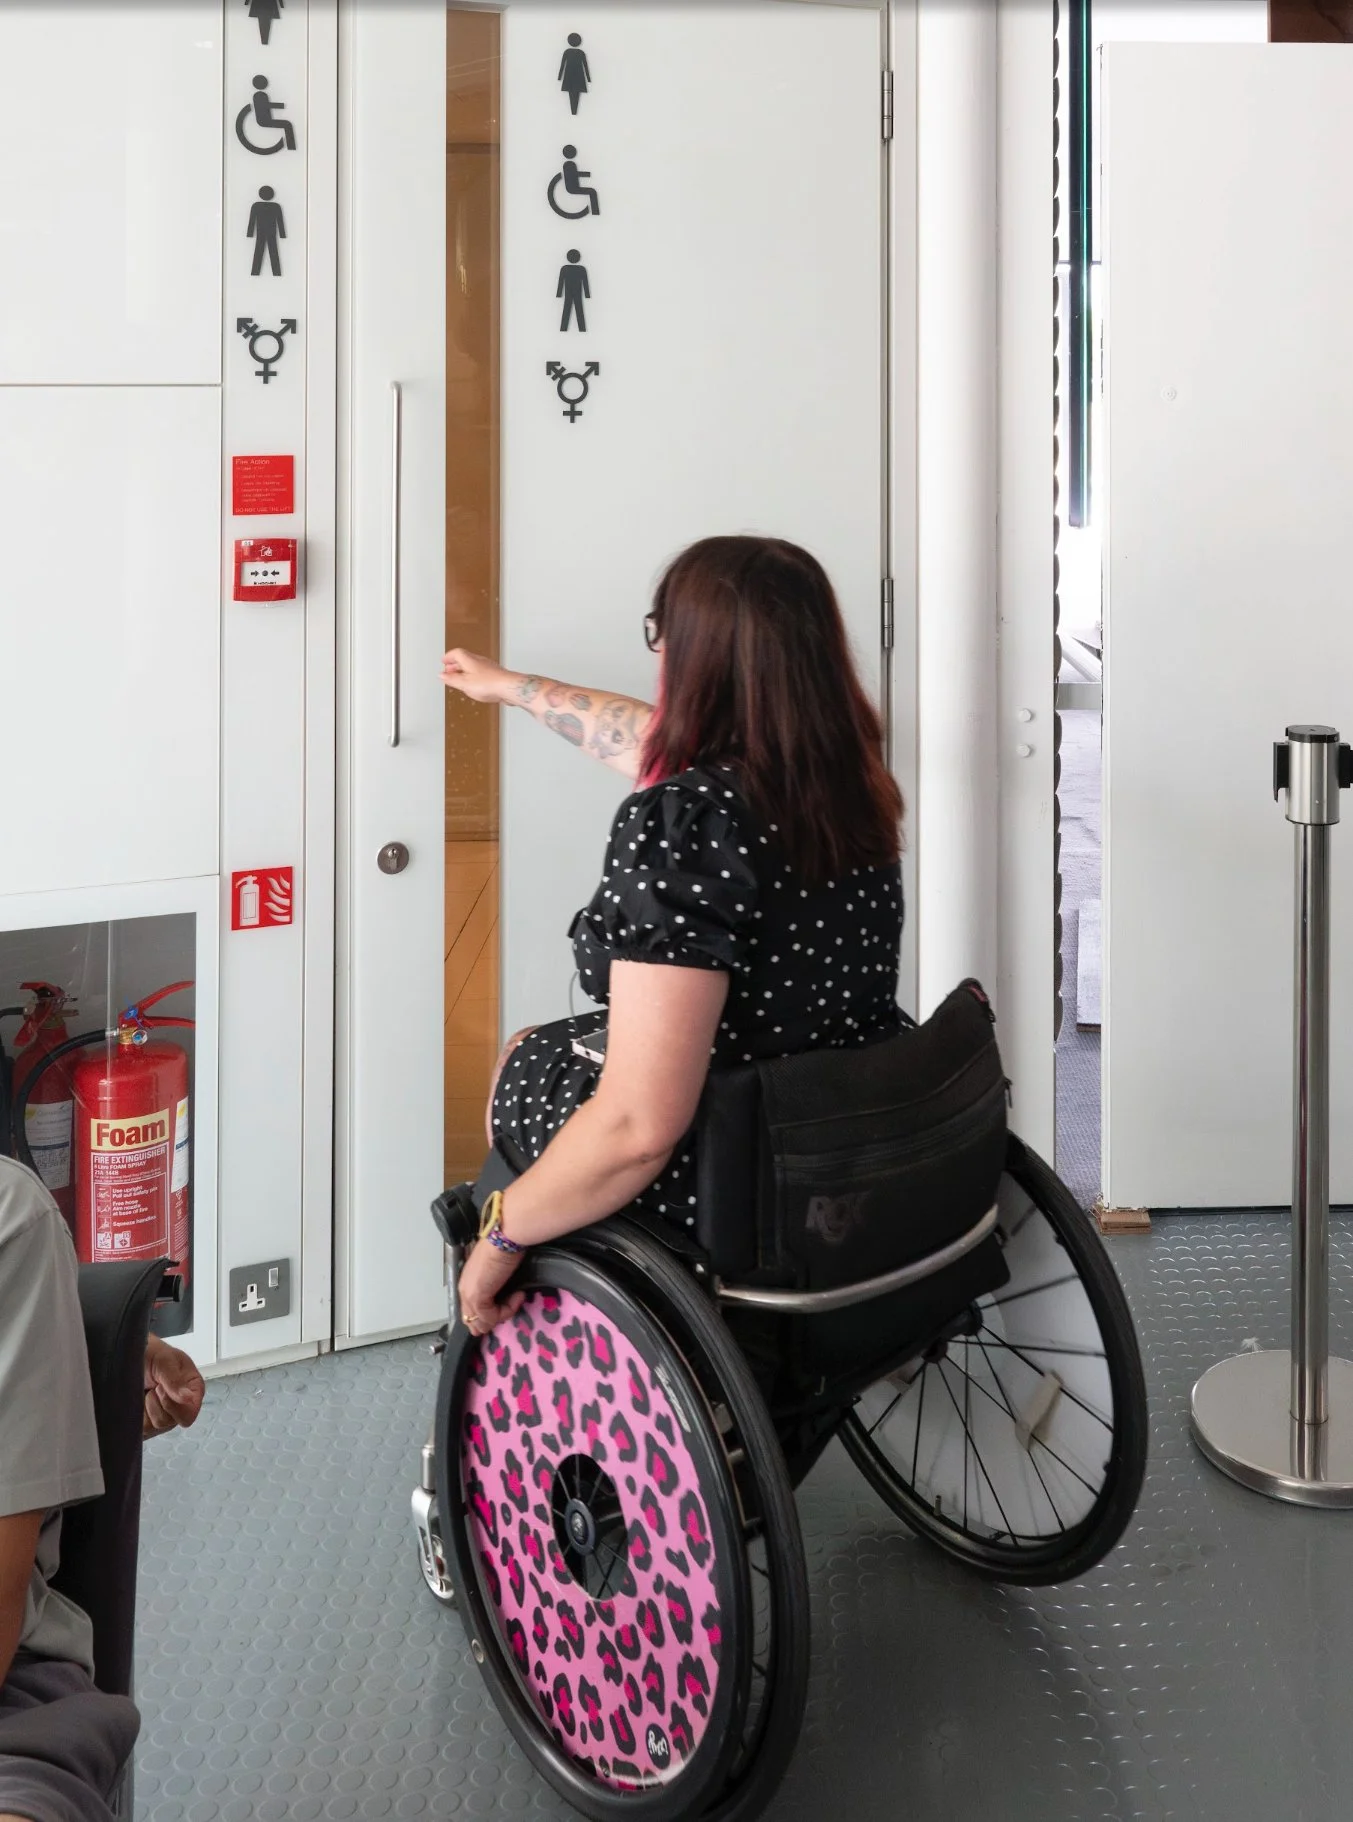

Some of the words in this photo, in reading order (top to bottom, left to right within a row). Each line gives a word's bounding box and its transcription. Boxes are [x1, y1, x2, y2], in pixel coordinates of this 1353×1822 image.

[96, 1120, 166, 1147] Foam
[94, 1156, 110, 1164] FIRE
[111, 1146, 166, 1164] EXTINGUISHER
[136, 1215, 157, 1223] handles
